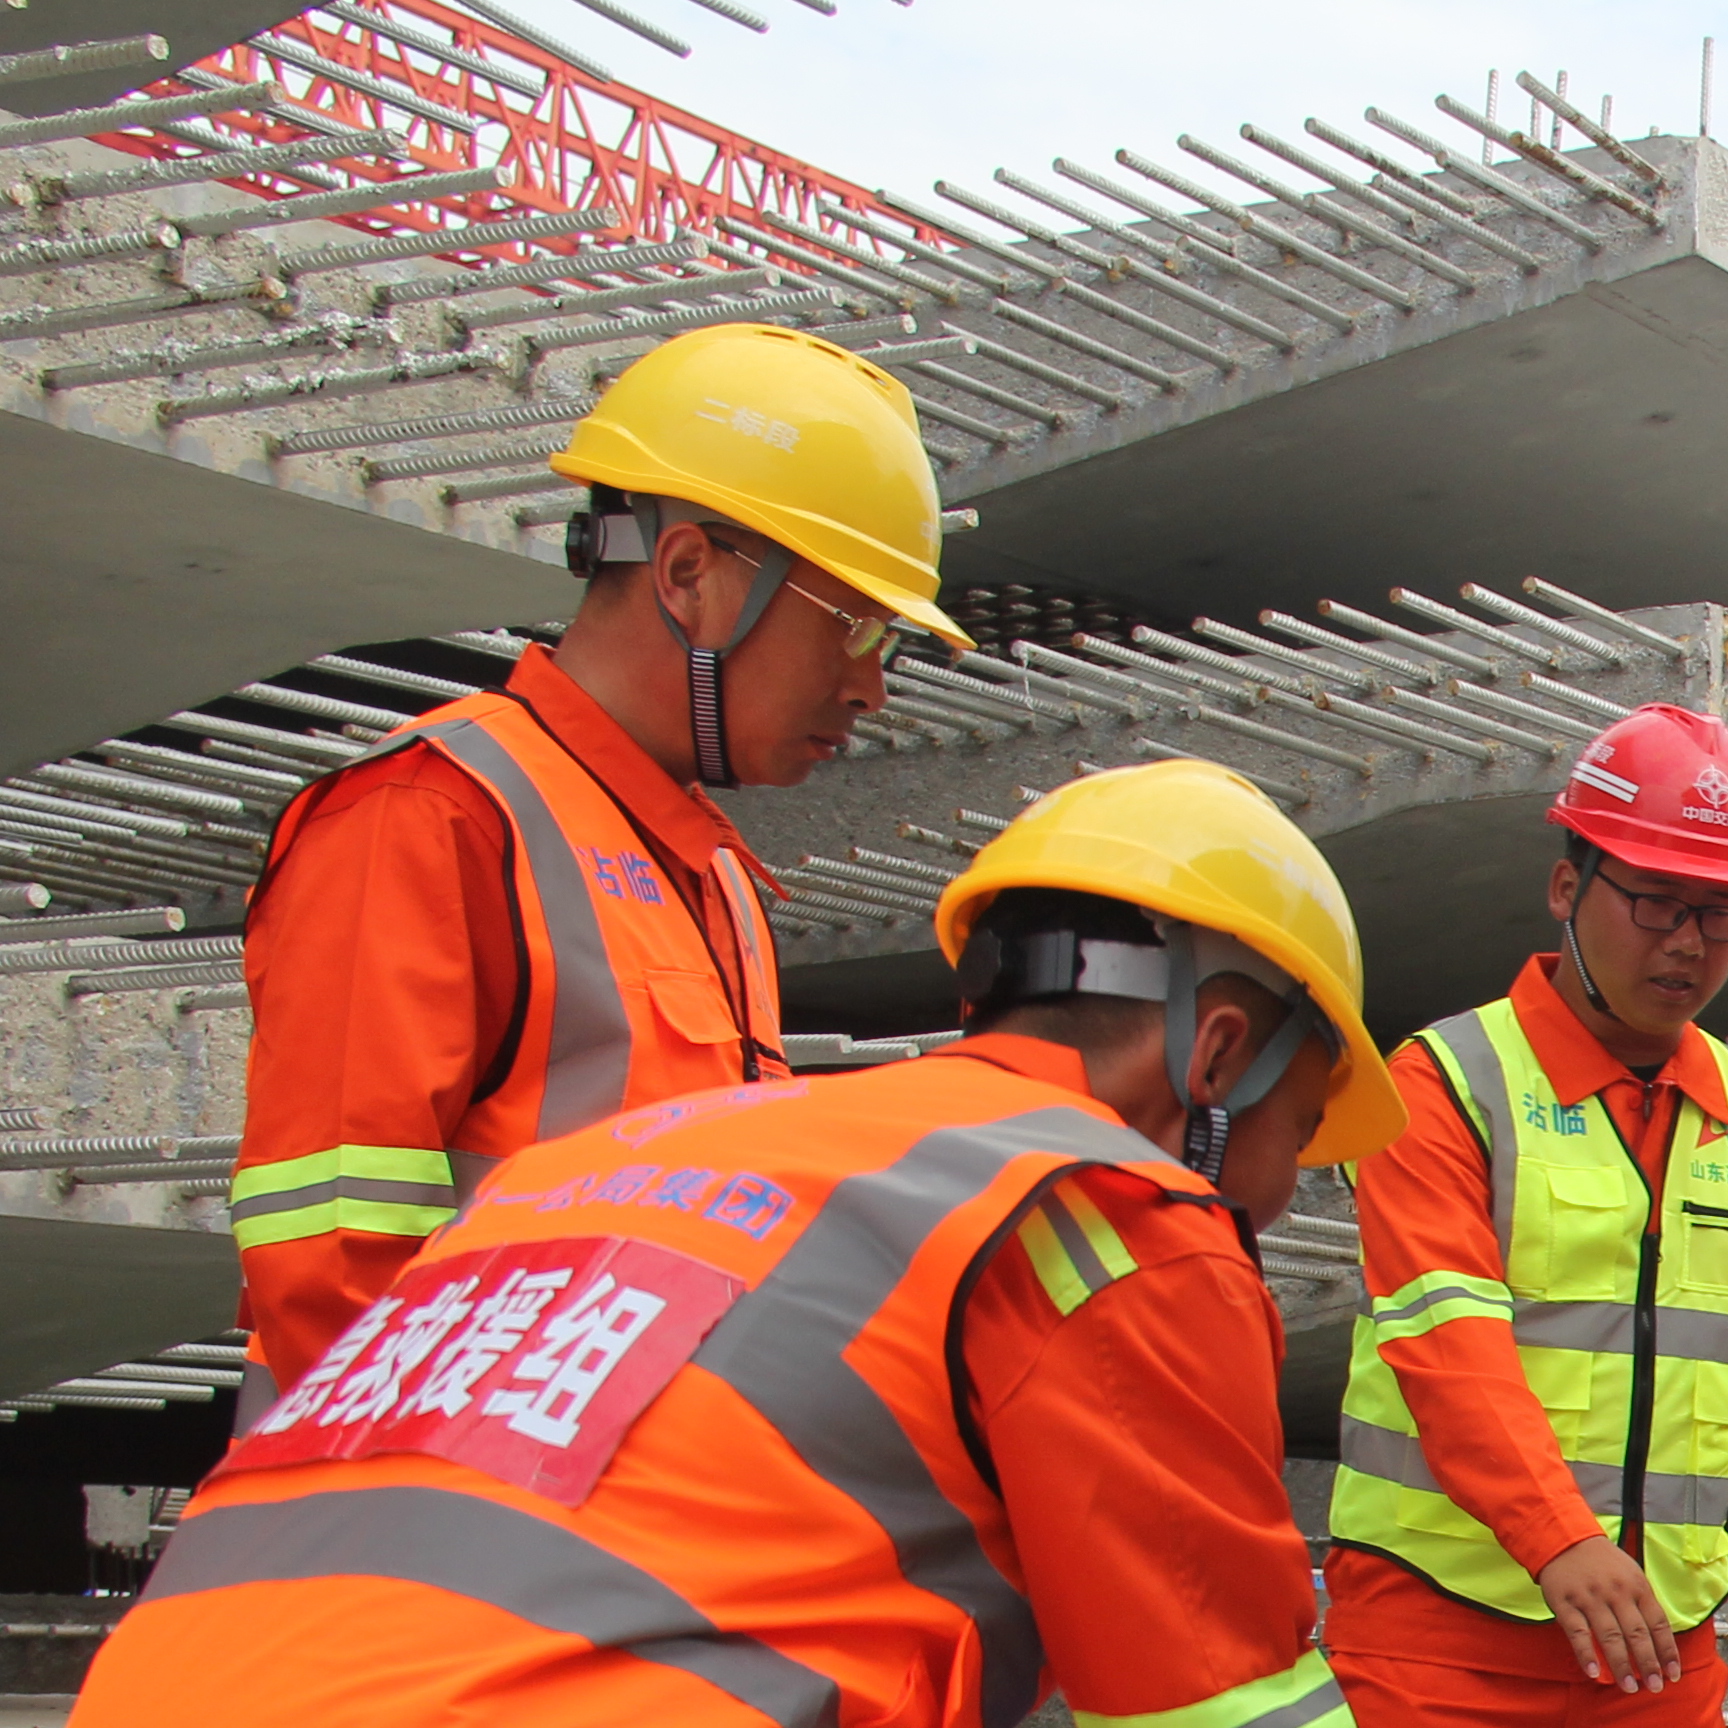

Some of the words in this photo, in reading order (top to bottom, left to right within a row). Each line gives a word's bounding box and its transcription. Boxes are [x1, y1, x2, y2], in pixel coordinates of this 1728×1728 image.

[694, 396, 801, 455] 二标段
[1522, 1092, 1589, 1137] 沾临
